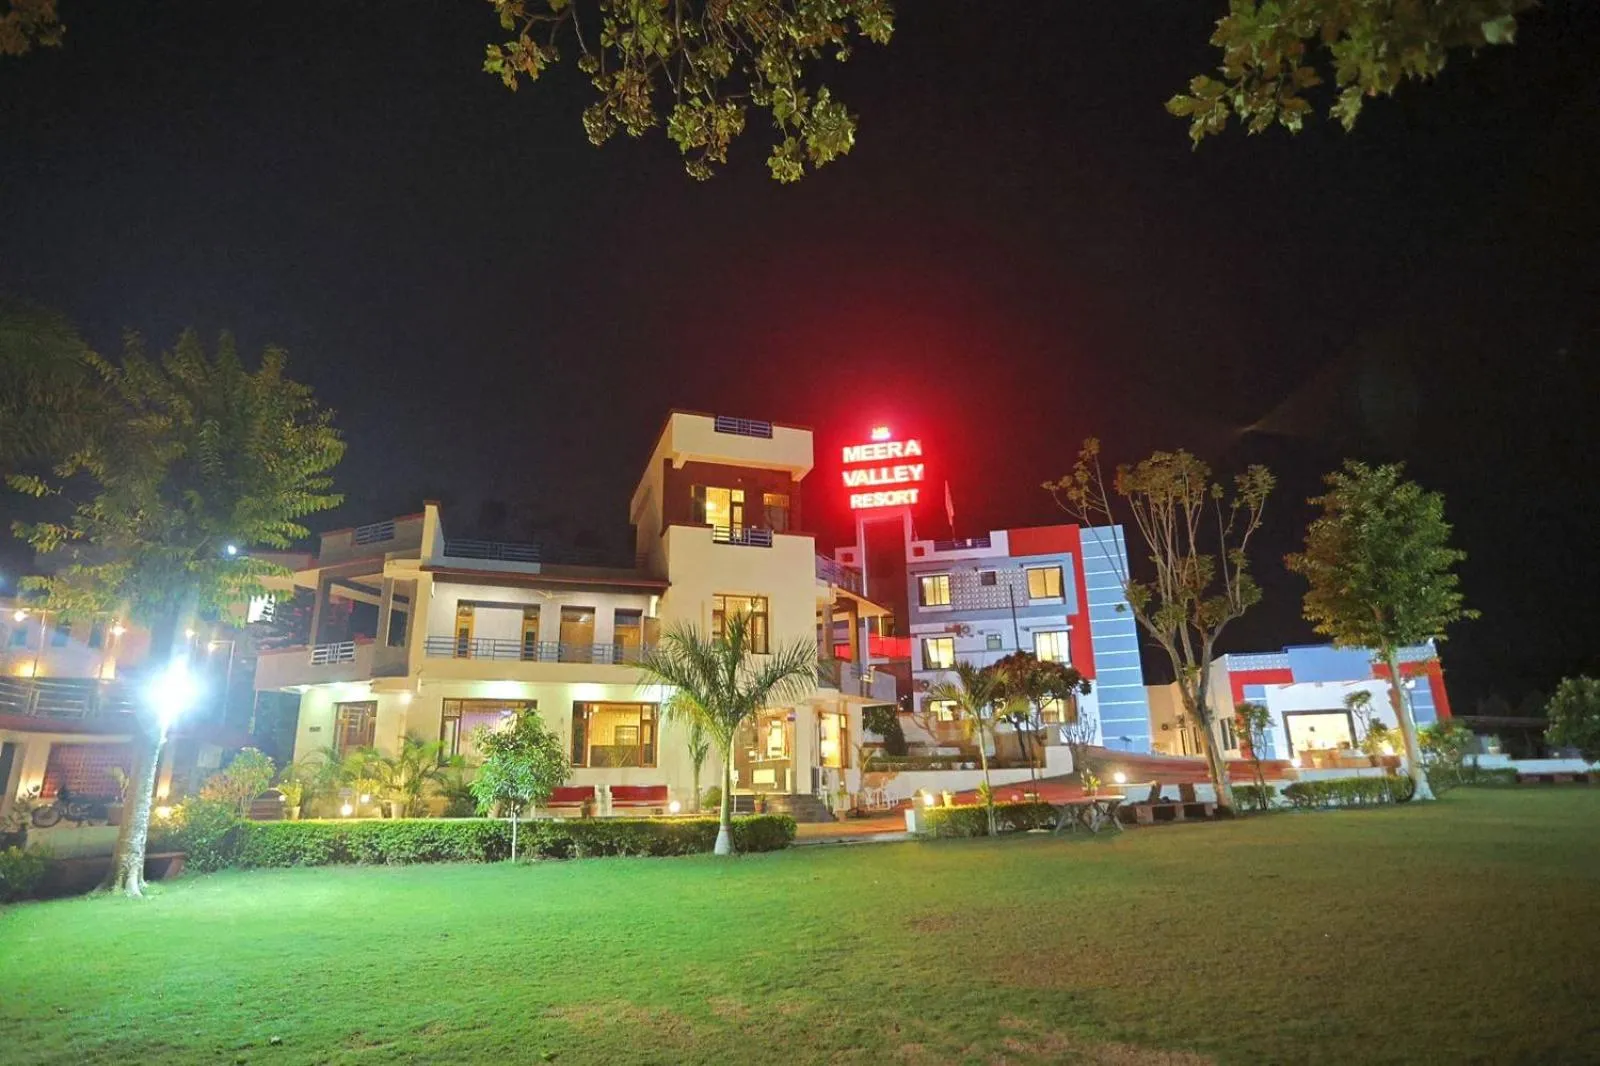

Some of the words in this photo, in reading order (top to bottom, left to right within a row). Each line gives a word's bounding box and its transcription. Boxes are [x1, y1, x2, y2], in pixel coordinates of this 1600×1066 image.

[842, 439, 922, 463] MEERA
[842, 463, 924, 487] VALLEY
[850, 488, 919, 509] RESORT
